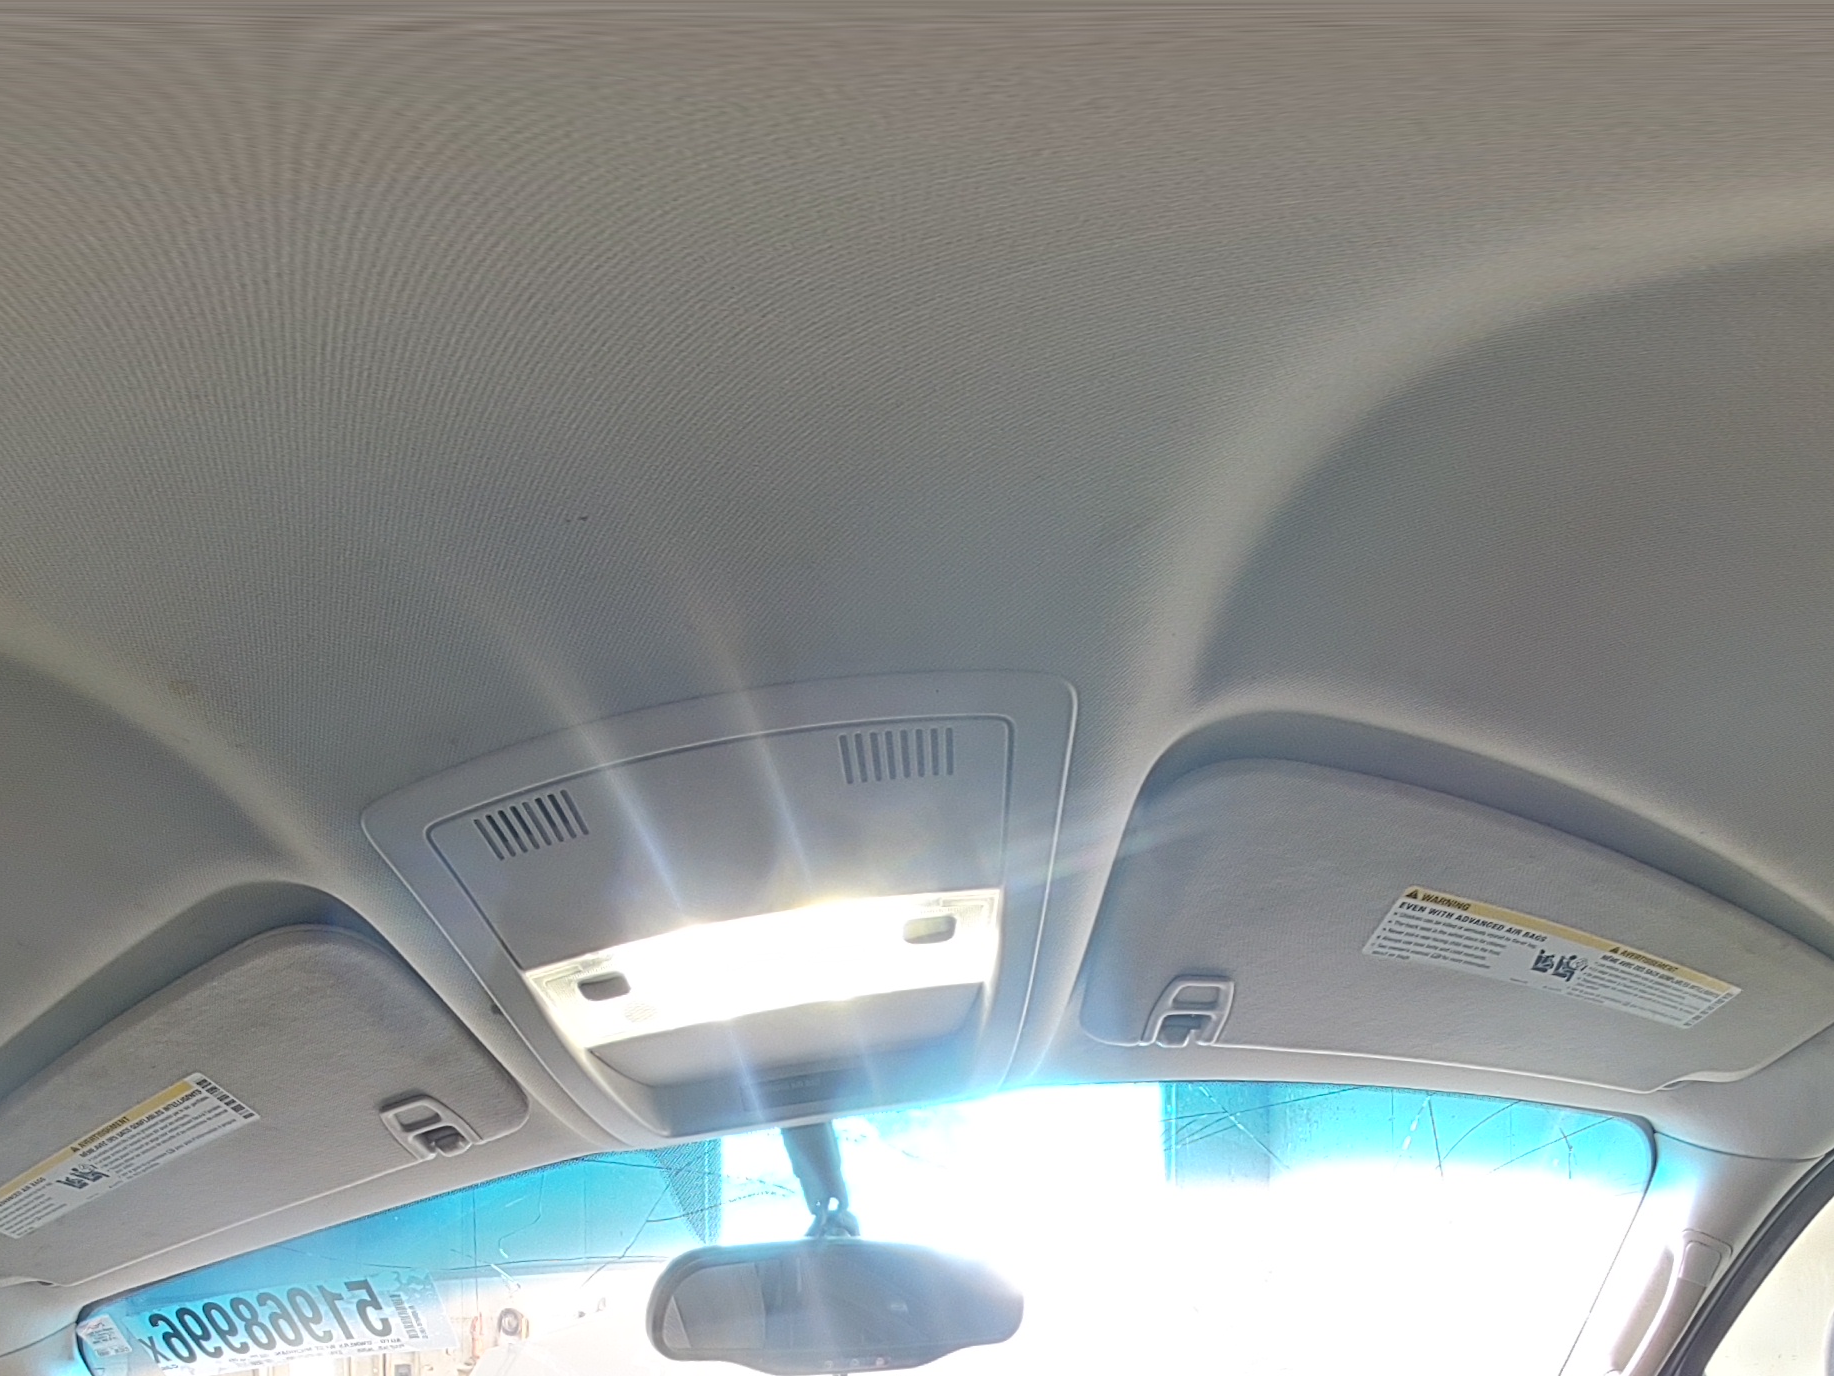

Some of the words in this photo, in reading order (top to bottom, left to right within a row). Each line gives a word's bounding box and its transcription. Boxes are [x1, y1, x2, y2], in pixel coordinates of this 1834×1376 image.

[1422, 892, 1471, 911] WARNING
[1399, 901, 1427, 912] EVEN
[1428, 907, 1455, 919] WITH
[1455, 914, 1505, 932] ADVANCED
[1505, 926, 1523, 936] AIR
[1522, 931, 1548, 943] BAGS
